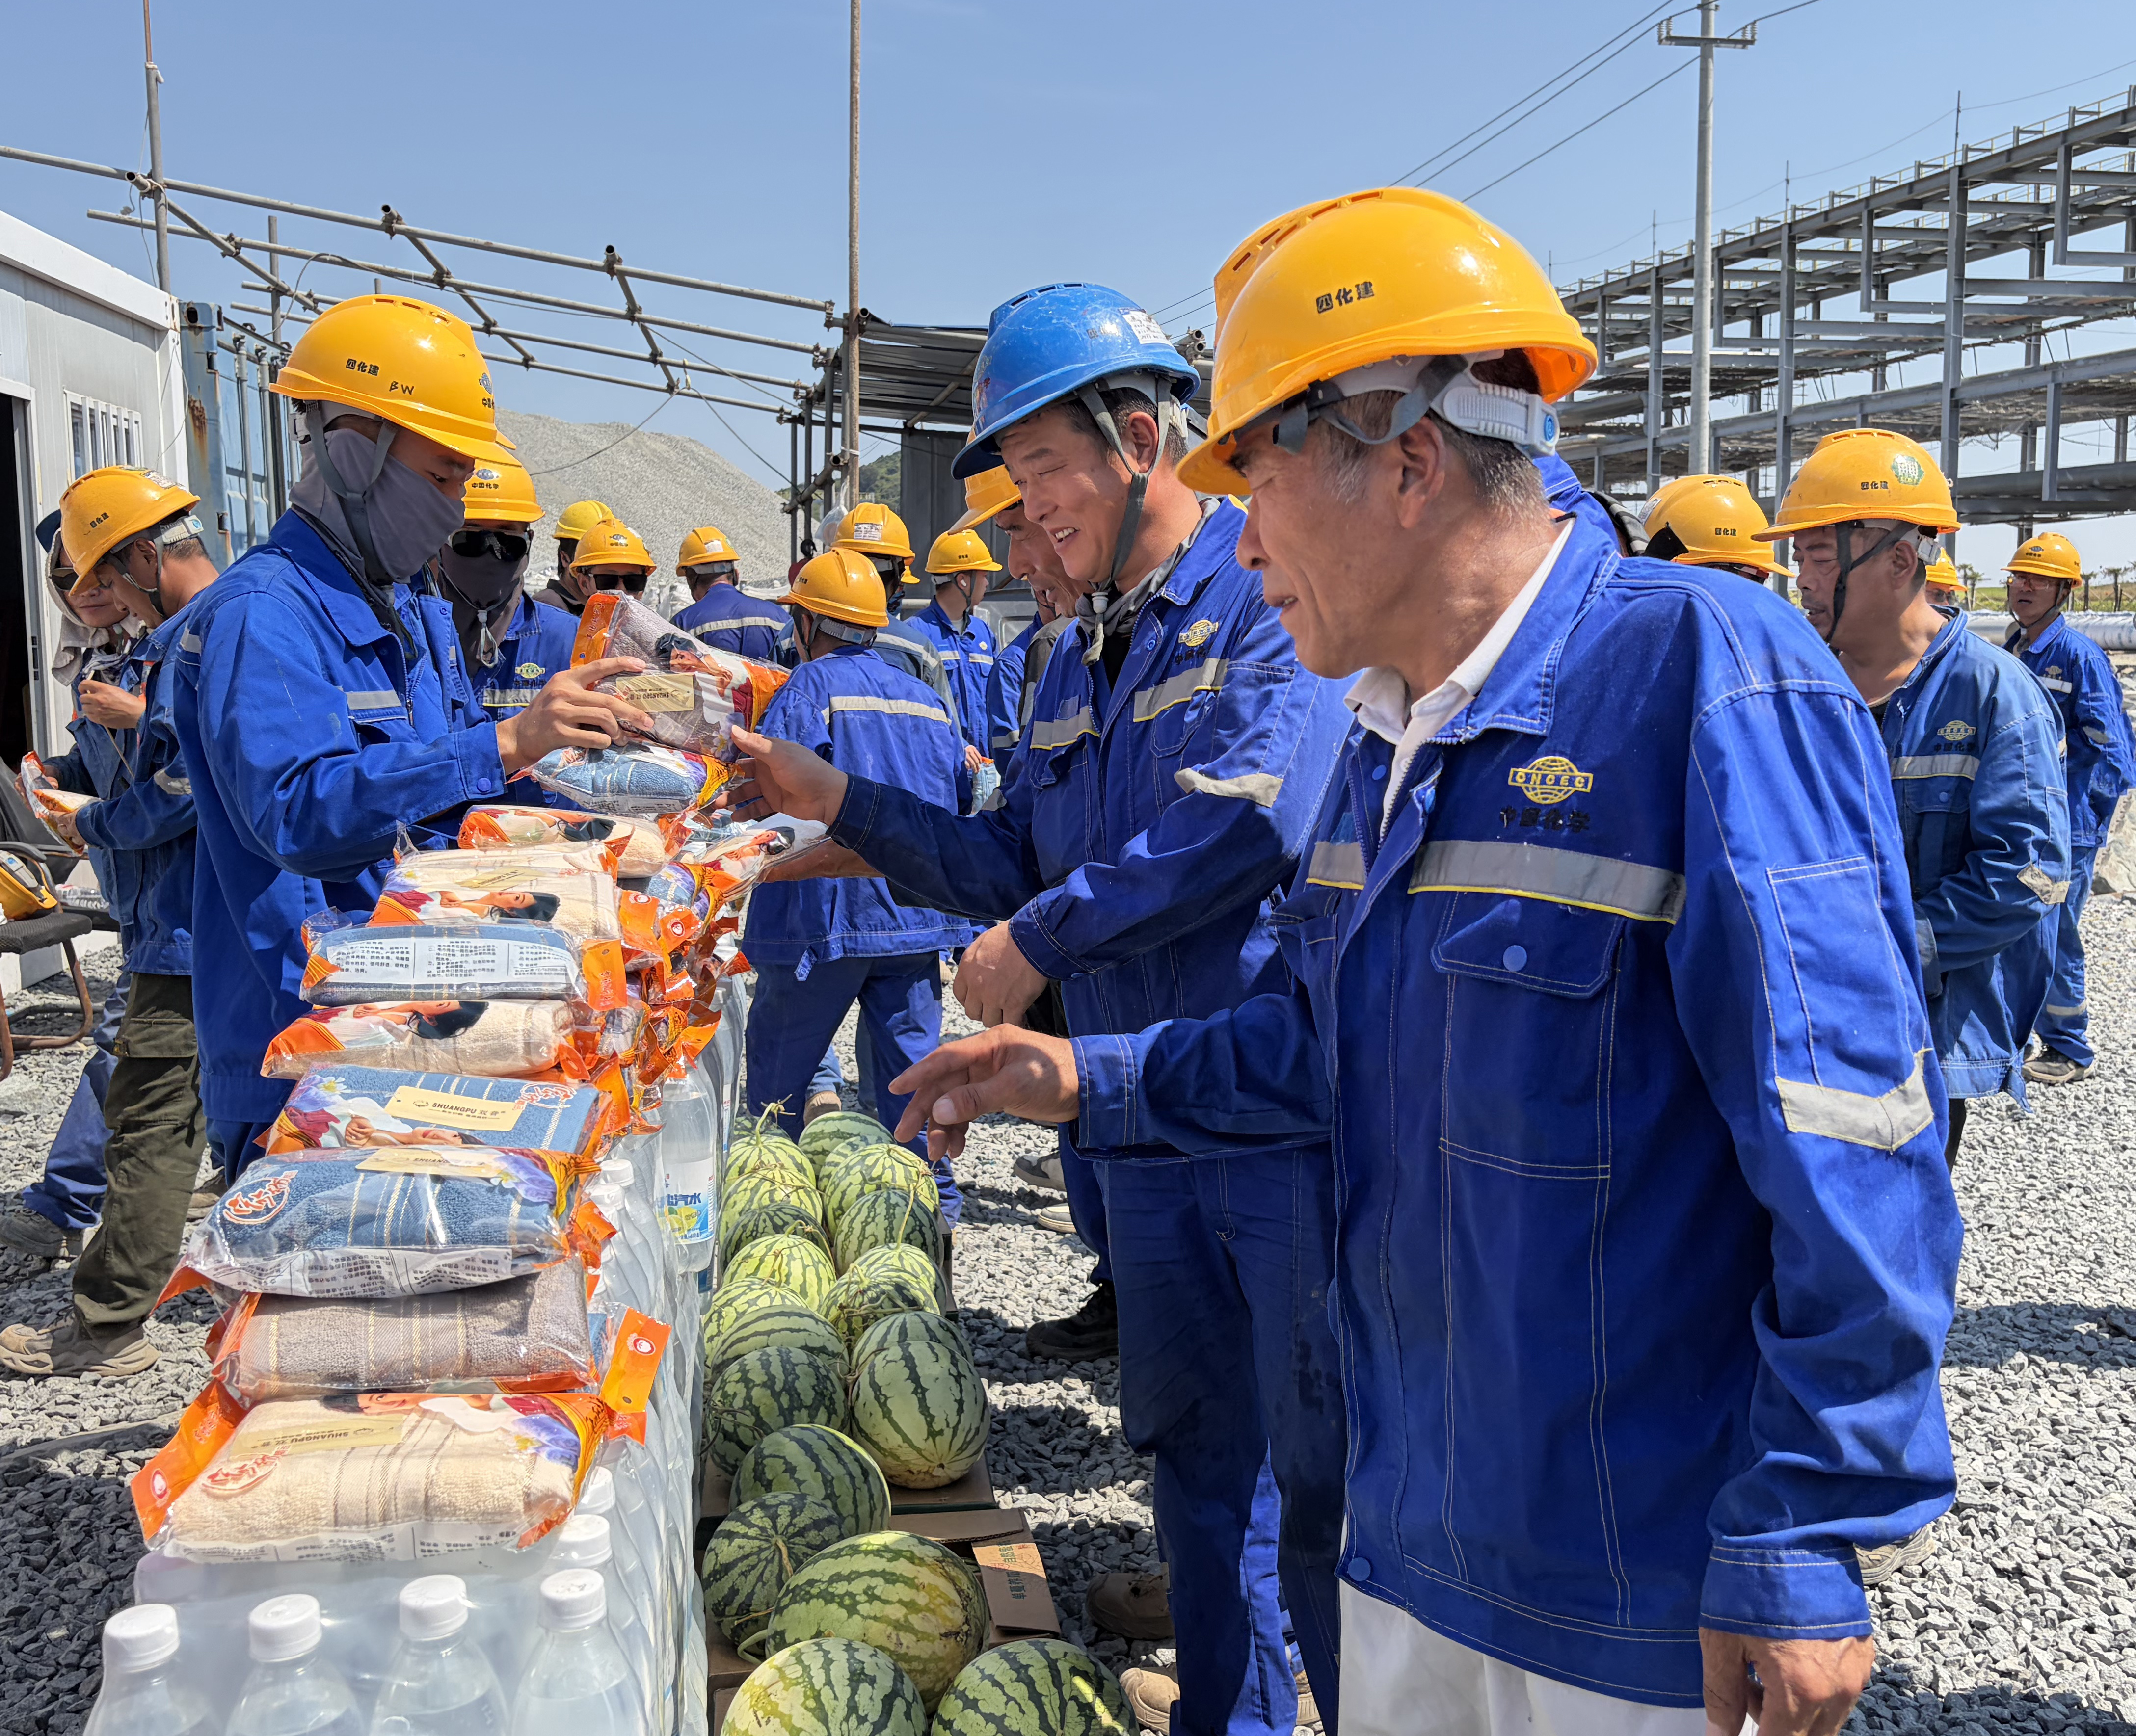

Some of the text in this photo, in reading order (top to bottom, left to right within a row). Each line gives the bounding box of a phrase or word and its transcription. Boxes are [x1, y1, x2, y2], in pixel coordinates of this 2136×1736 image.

[1316, 281, 1375, 314] 四化建
[345, 358, 380, 376] 四化建
[1515, 771, 1585, 788] CNCEC
[1499, 804, 1591, 833] 中国化学
[432, 1102, 477, 1114] SHUANGPU
[290, 1431, 349, 1444] SHUANGPU
